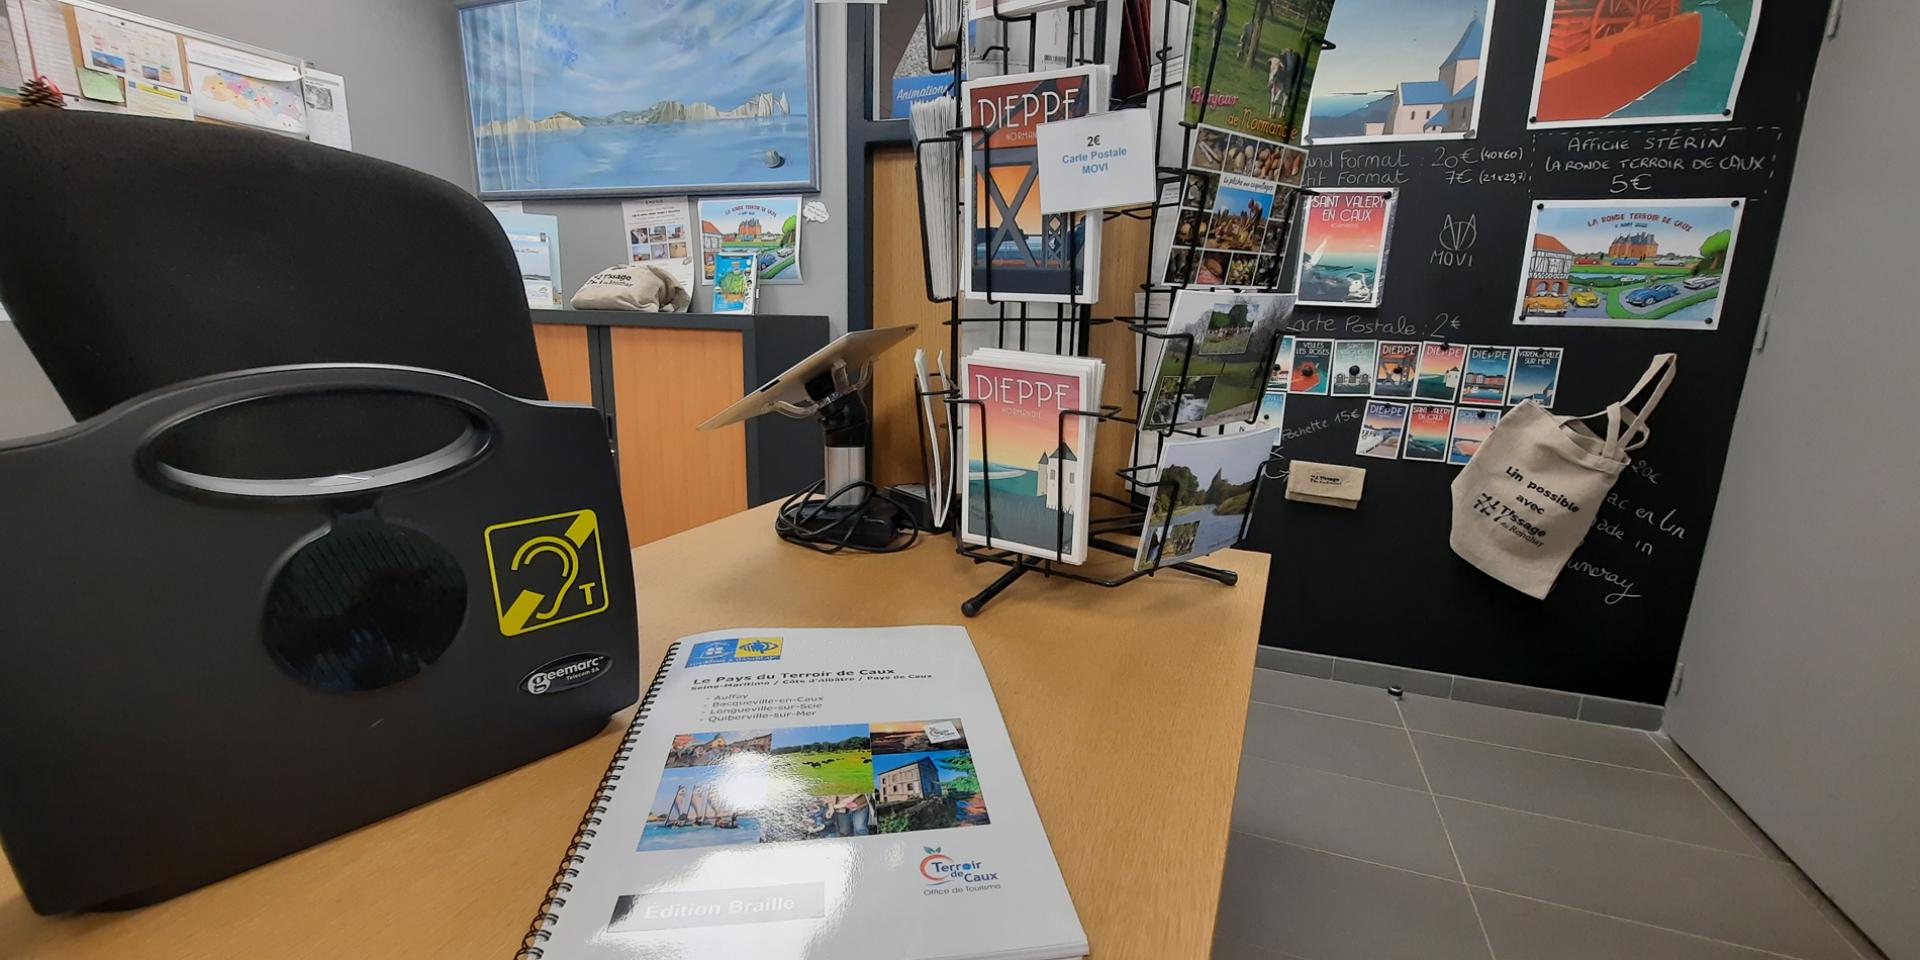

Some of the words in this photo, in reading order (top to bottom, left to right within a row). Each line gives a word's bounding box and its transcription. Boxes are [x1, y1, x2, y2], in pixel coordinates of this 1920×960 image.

[978, 87, 1079, 129] DIEPPE
[1242, 107, 1298, 139] Normande
[1005, 129, 1038, 143] NORMAN
[1087, 134, 1101, 147] 2€
[1062, 152, 1089, 164] Carte
[1090, 146, 1127, 160] Postale
[1306, 151, 1332, 168] and
[1340, 148, 1410, 171] Format
[1431, 145, 1480, 169] 20€
[1564, 157, 1609, 172] RONDE
[1618, 156, 1686, 171] TERROIR
[1691, 157, 1714, 171] DE
[1719, 154, 1766, 171] CAUX
[1082, 162, 1109, 175] MOVI
[1302, 170, 1327, 187] tit
[1337, 168, 1410, 186] Format
[1444, 169, 1473, 185] 7€
[1609, 173, 1652, 194] 5€
[1345, 194, 1385, 208] VALERY
[1322, 208, 1336, 222] EN
[1339, 208, 1373, 222] CAUX
[1430, 250, 1473, 267] MOVI
[1430, 312, 1462, 338] 2€
[1382, 345, 1417, 356] DIEPPE
[1426, 347, 1462, 358] DIEPE
[975, 374, 1070, 411] DIEPPE
[1334, 408, 1361, 424] 15€
[1505, 466, 1524, 482] Lin
[1526, 481, 1580, 513] possible
[1515, 494, 1545, 515] avec
[1607, 492, 1629, 510] ac
[1596, 519, 1625, 540] ade
[1567, 560, 1642, 605] uneray
[579, 582, 596, 606] T
[566, 671, 591, 681] Telecom
[782, 671, 832, 679] Terroir
[931, 861, 982, 873] Terroir
[964, 873, 999, 883] Caux
[965, 884, 1001, 892] Tourisme
[728, 897, 795, 914] Braille
